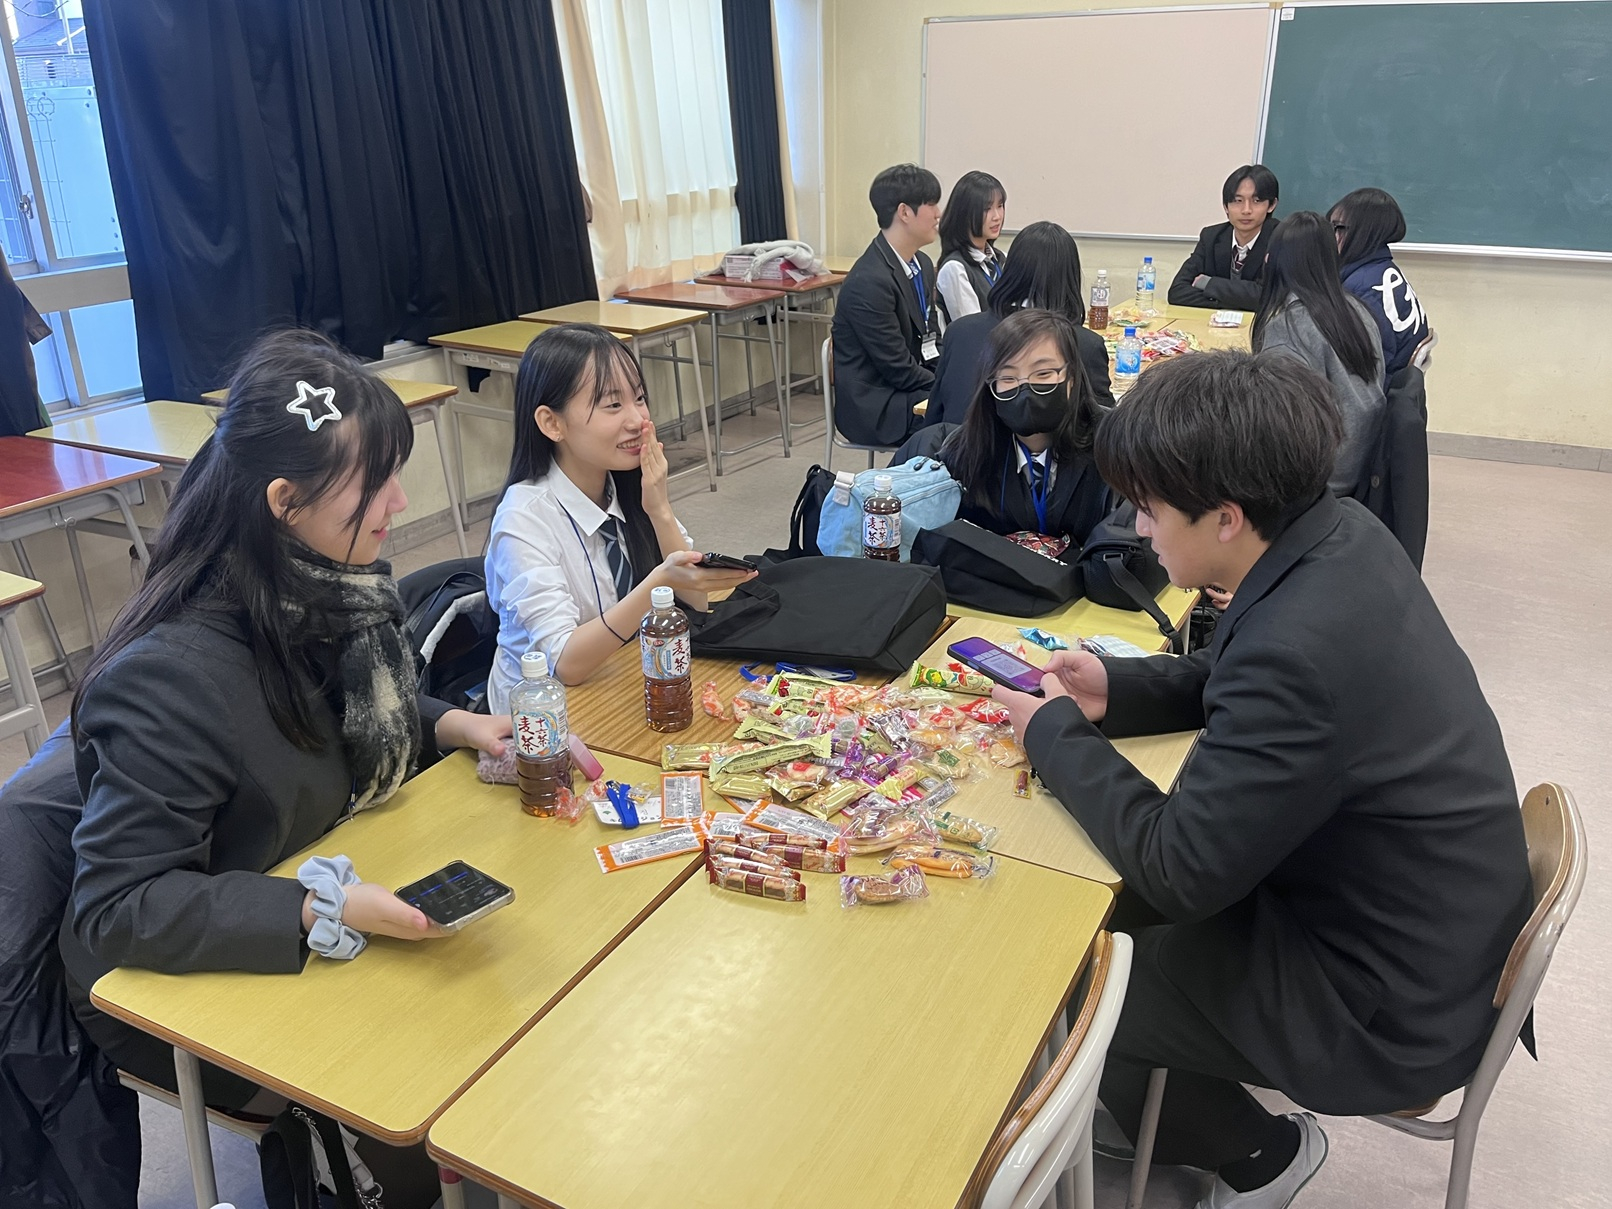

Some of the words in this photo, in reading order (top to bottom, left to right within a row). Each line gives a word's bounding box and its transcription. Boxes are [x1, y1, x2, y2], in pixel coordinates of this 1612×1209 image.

[867, 516, 879, 545] 麦茶
[672, 638, 688, 674] 麦茶
[518, 715, 540, 754] 麦茶
[535, 717, 550, 748] 十六茶
